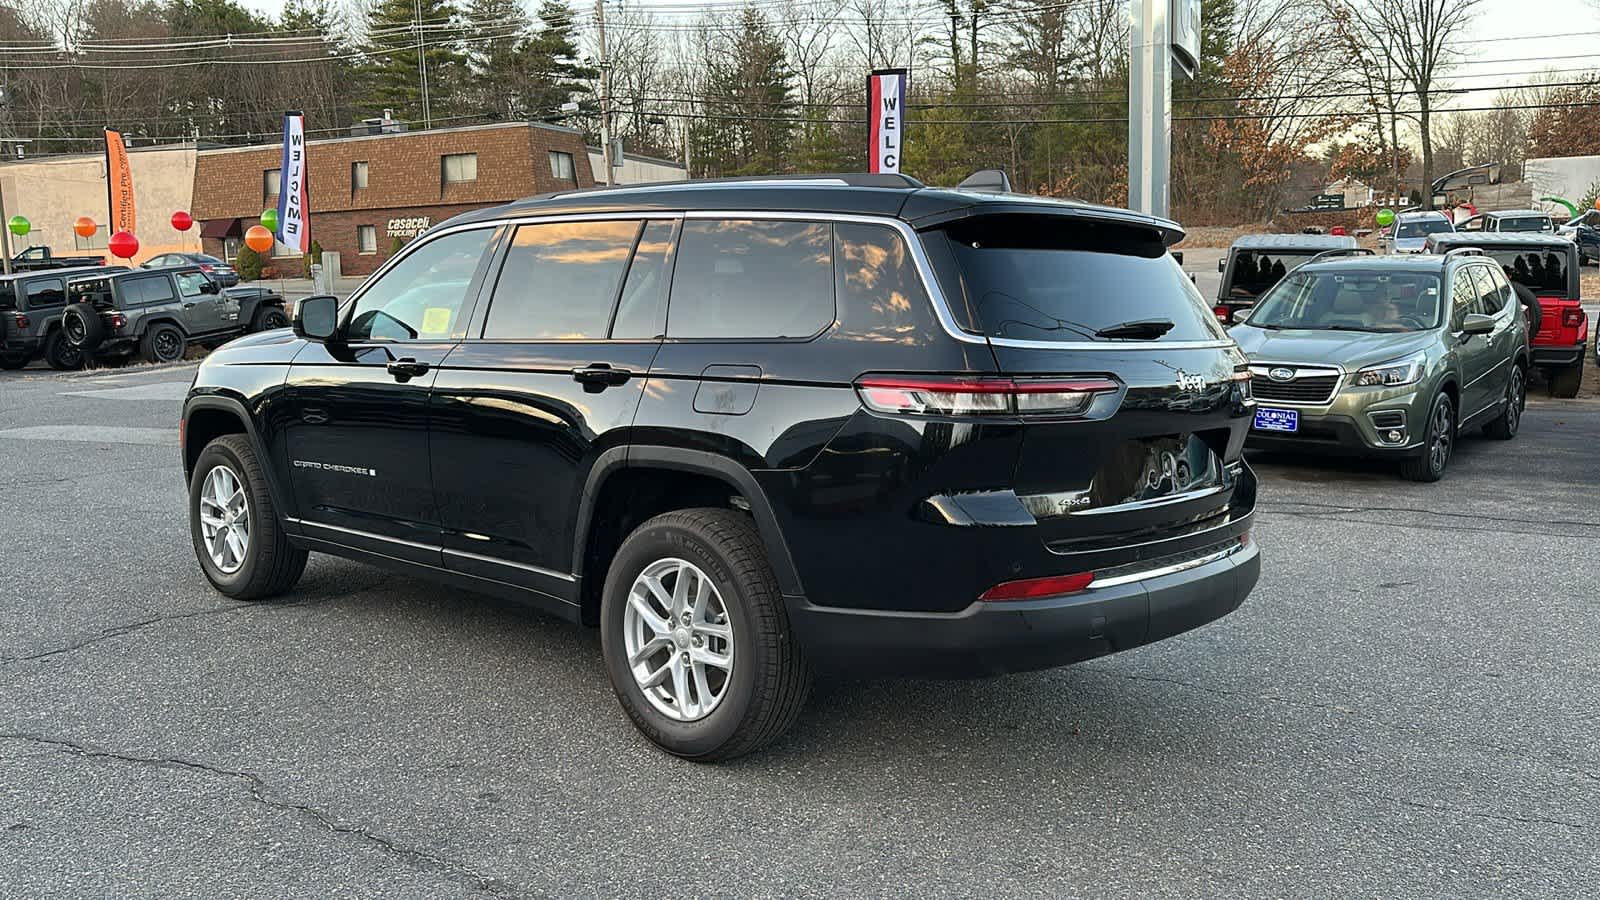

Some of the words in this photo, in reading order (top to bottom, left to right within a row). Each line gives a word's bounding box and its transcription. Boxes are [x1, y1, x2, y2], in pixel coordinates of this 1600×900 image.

[119, 190, 129, 228] Certified
[387, 216, 430, 230] casaceli
[1176, 371, 1206, 393] Jeep
[1256, 411, 1297, 420] COLONIAL
[323, 463, 368, 475] CHEROKEE
